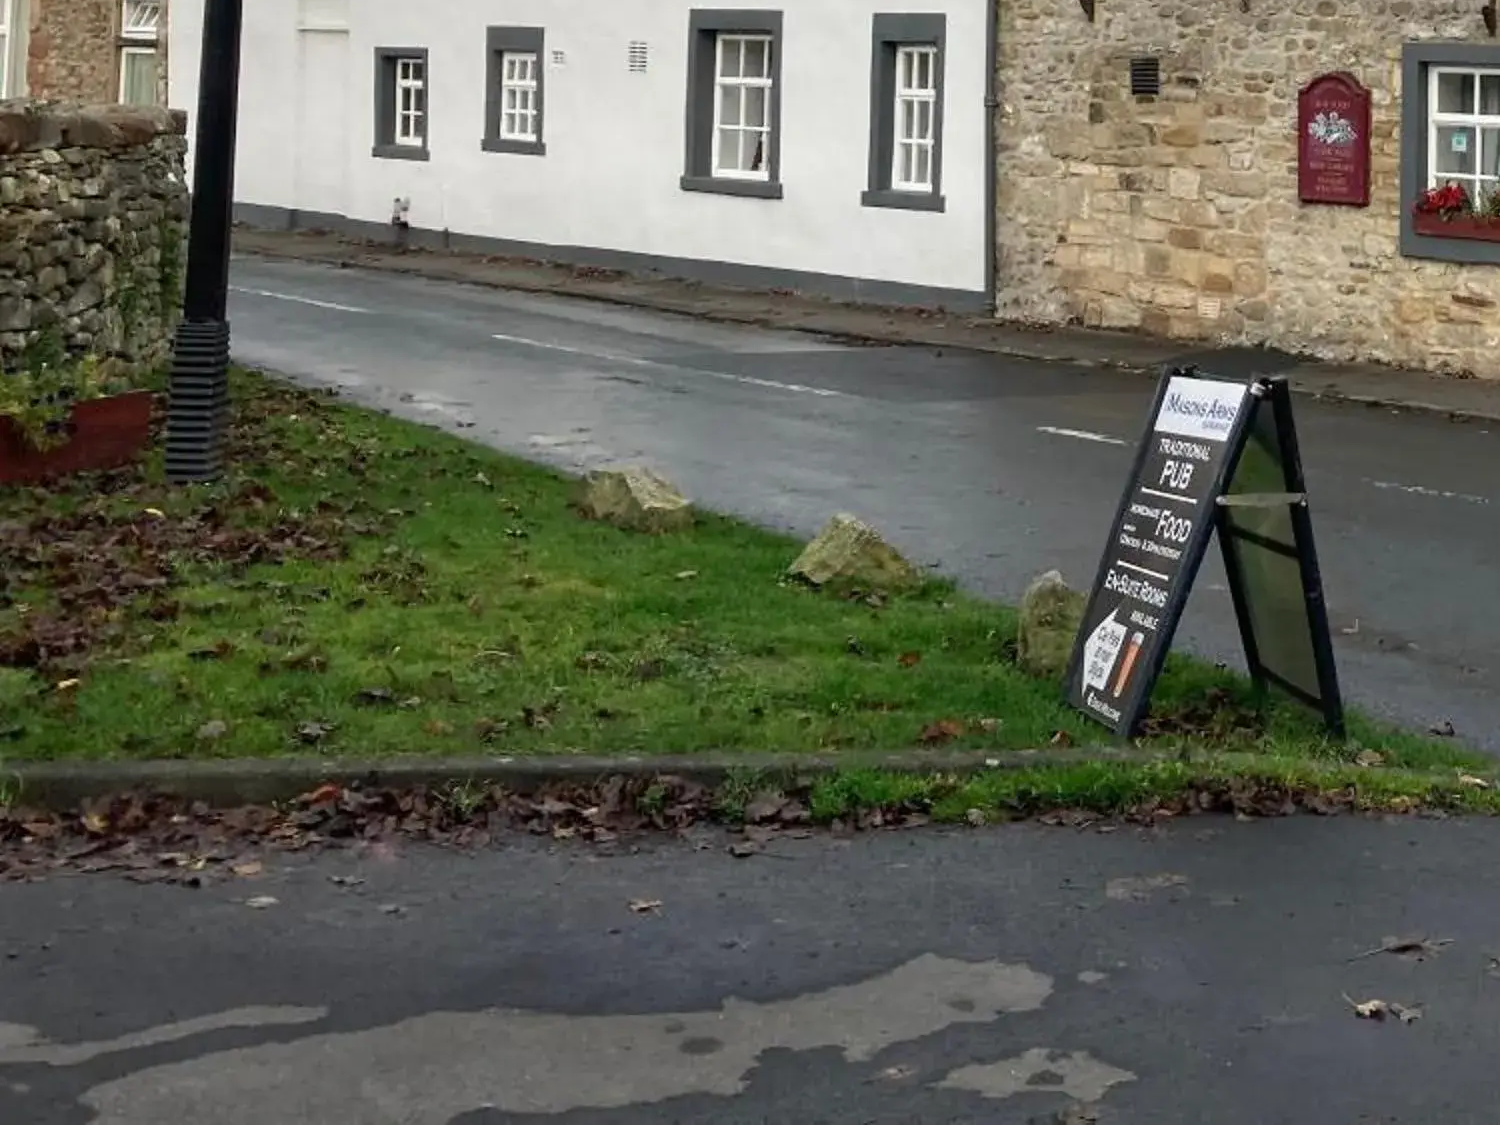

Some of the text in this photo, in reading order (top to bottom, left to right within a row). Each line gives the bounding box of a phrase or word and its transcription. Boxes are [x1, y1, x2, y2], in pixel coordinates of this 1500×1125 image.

[1159, 437, 1211, 461] TRADITIONAL
[1159, 460, 1194, 489] PUB
[1155, 509, 1192, 543] FOOD
